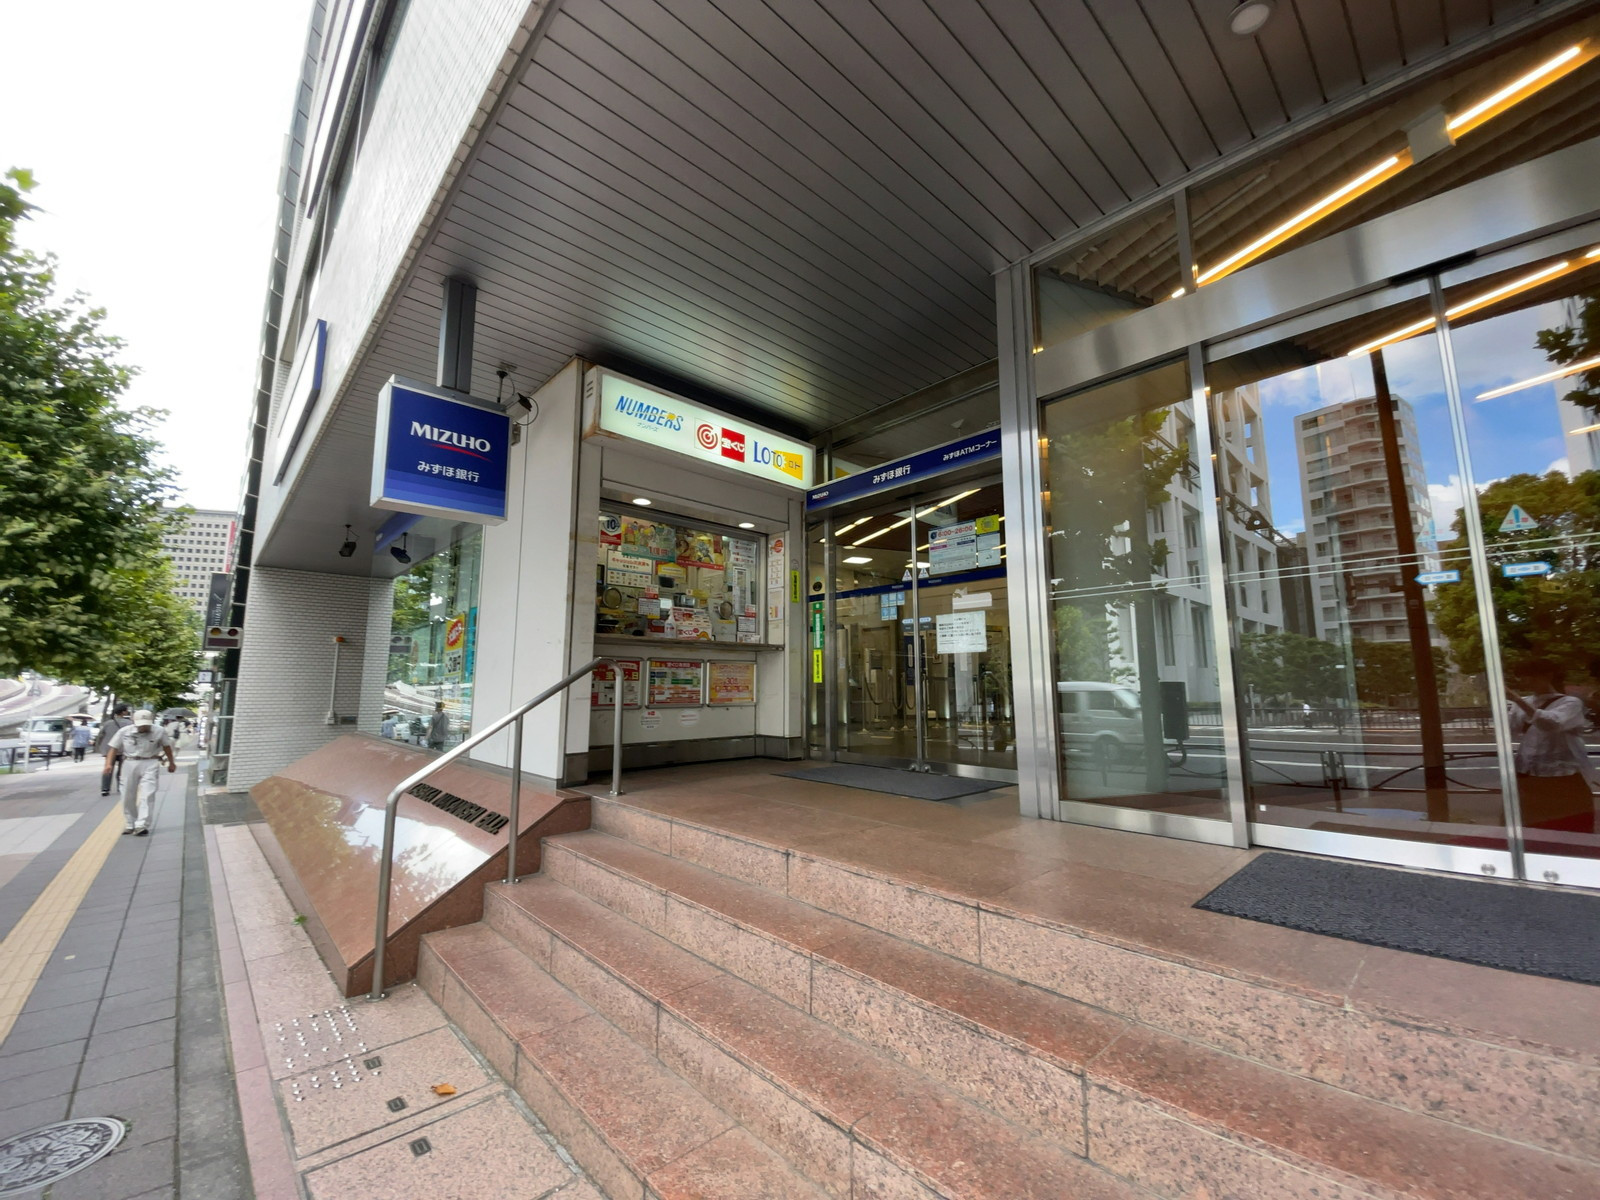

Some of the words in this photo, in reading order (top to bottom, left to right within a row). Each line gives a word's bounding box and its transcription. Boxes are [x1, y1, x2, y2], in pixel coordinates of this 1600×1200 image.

[615, 395, 684, 432] NUMBERS
[410, 421, 491, 452] MIZUHO
[721, 437, 745, 453] 宝くじ
[753, 440, 784, 468] LOTO
[943, 440, 997, 461] みずほATMコーナー
[417, 460, 480, 483] みずほ銀行
[872, 464, 911, 484] みずほ銀行
[811, 490, 829, 500] MIZUHO
